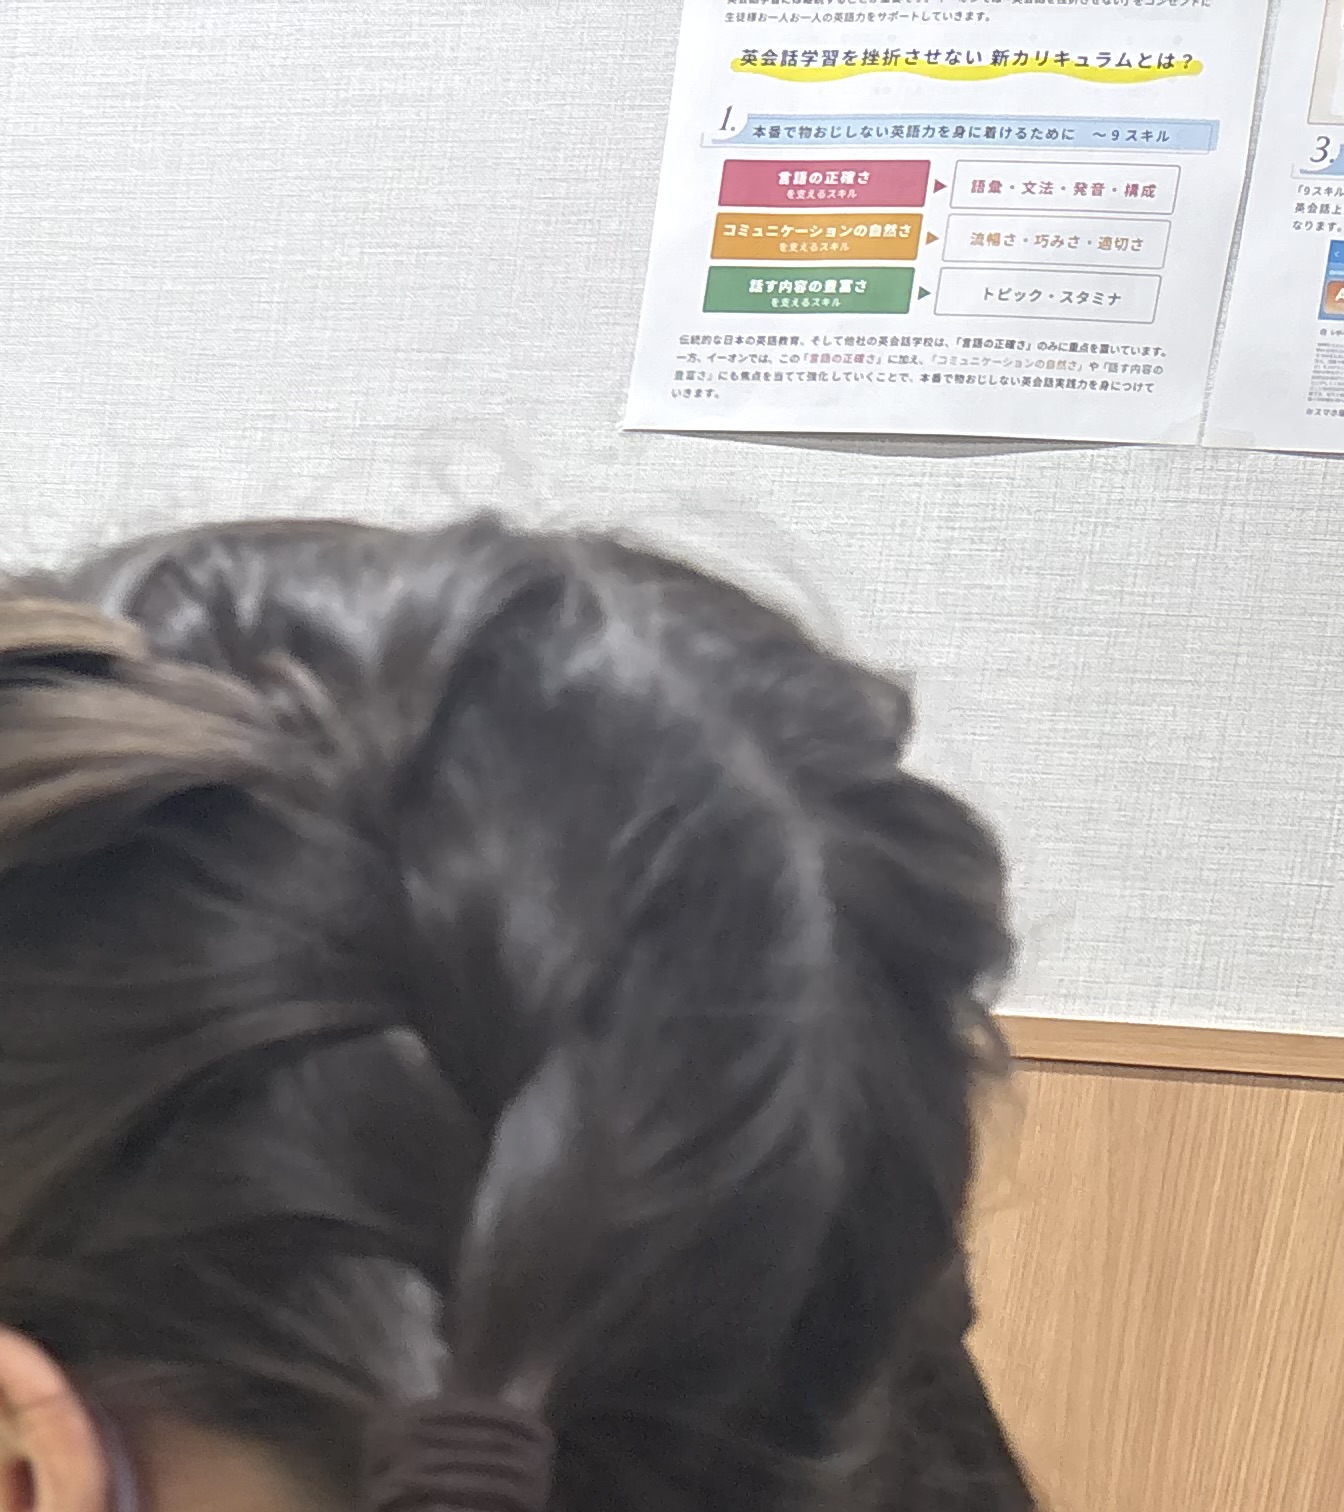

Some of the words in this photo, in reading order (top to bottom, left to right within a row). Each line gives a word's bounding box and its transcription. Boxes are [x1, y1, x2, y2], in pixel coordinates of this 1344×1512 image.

[739, 49, 983, 67] 英会話学習を挫折させない
[990, 49, 1194, 70] 新カリキュラムとは？
[718, 105, 736, 132] 1.
[752, 124, 1076, 142] 本番で物おじしない英語力を身に着けるために
[1310, 135, 1335, 163] 3.
[777, 170, 872, 185] 言語の正確さ
[786, 188, 858, 200] を支えるスキル
[722, 223, 912, 239] コミュニケーションの自然さ
[1292, 220, 1342, 233] なります。
[778, 242, 851, 253] を支えるスキル
[748, 278, 868, 294] 話す内容の豊富さ
[769, 297, 842, 308] を支えるスキル
[983, 287, 1122, 307] トピック・スタミナ
